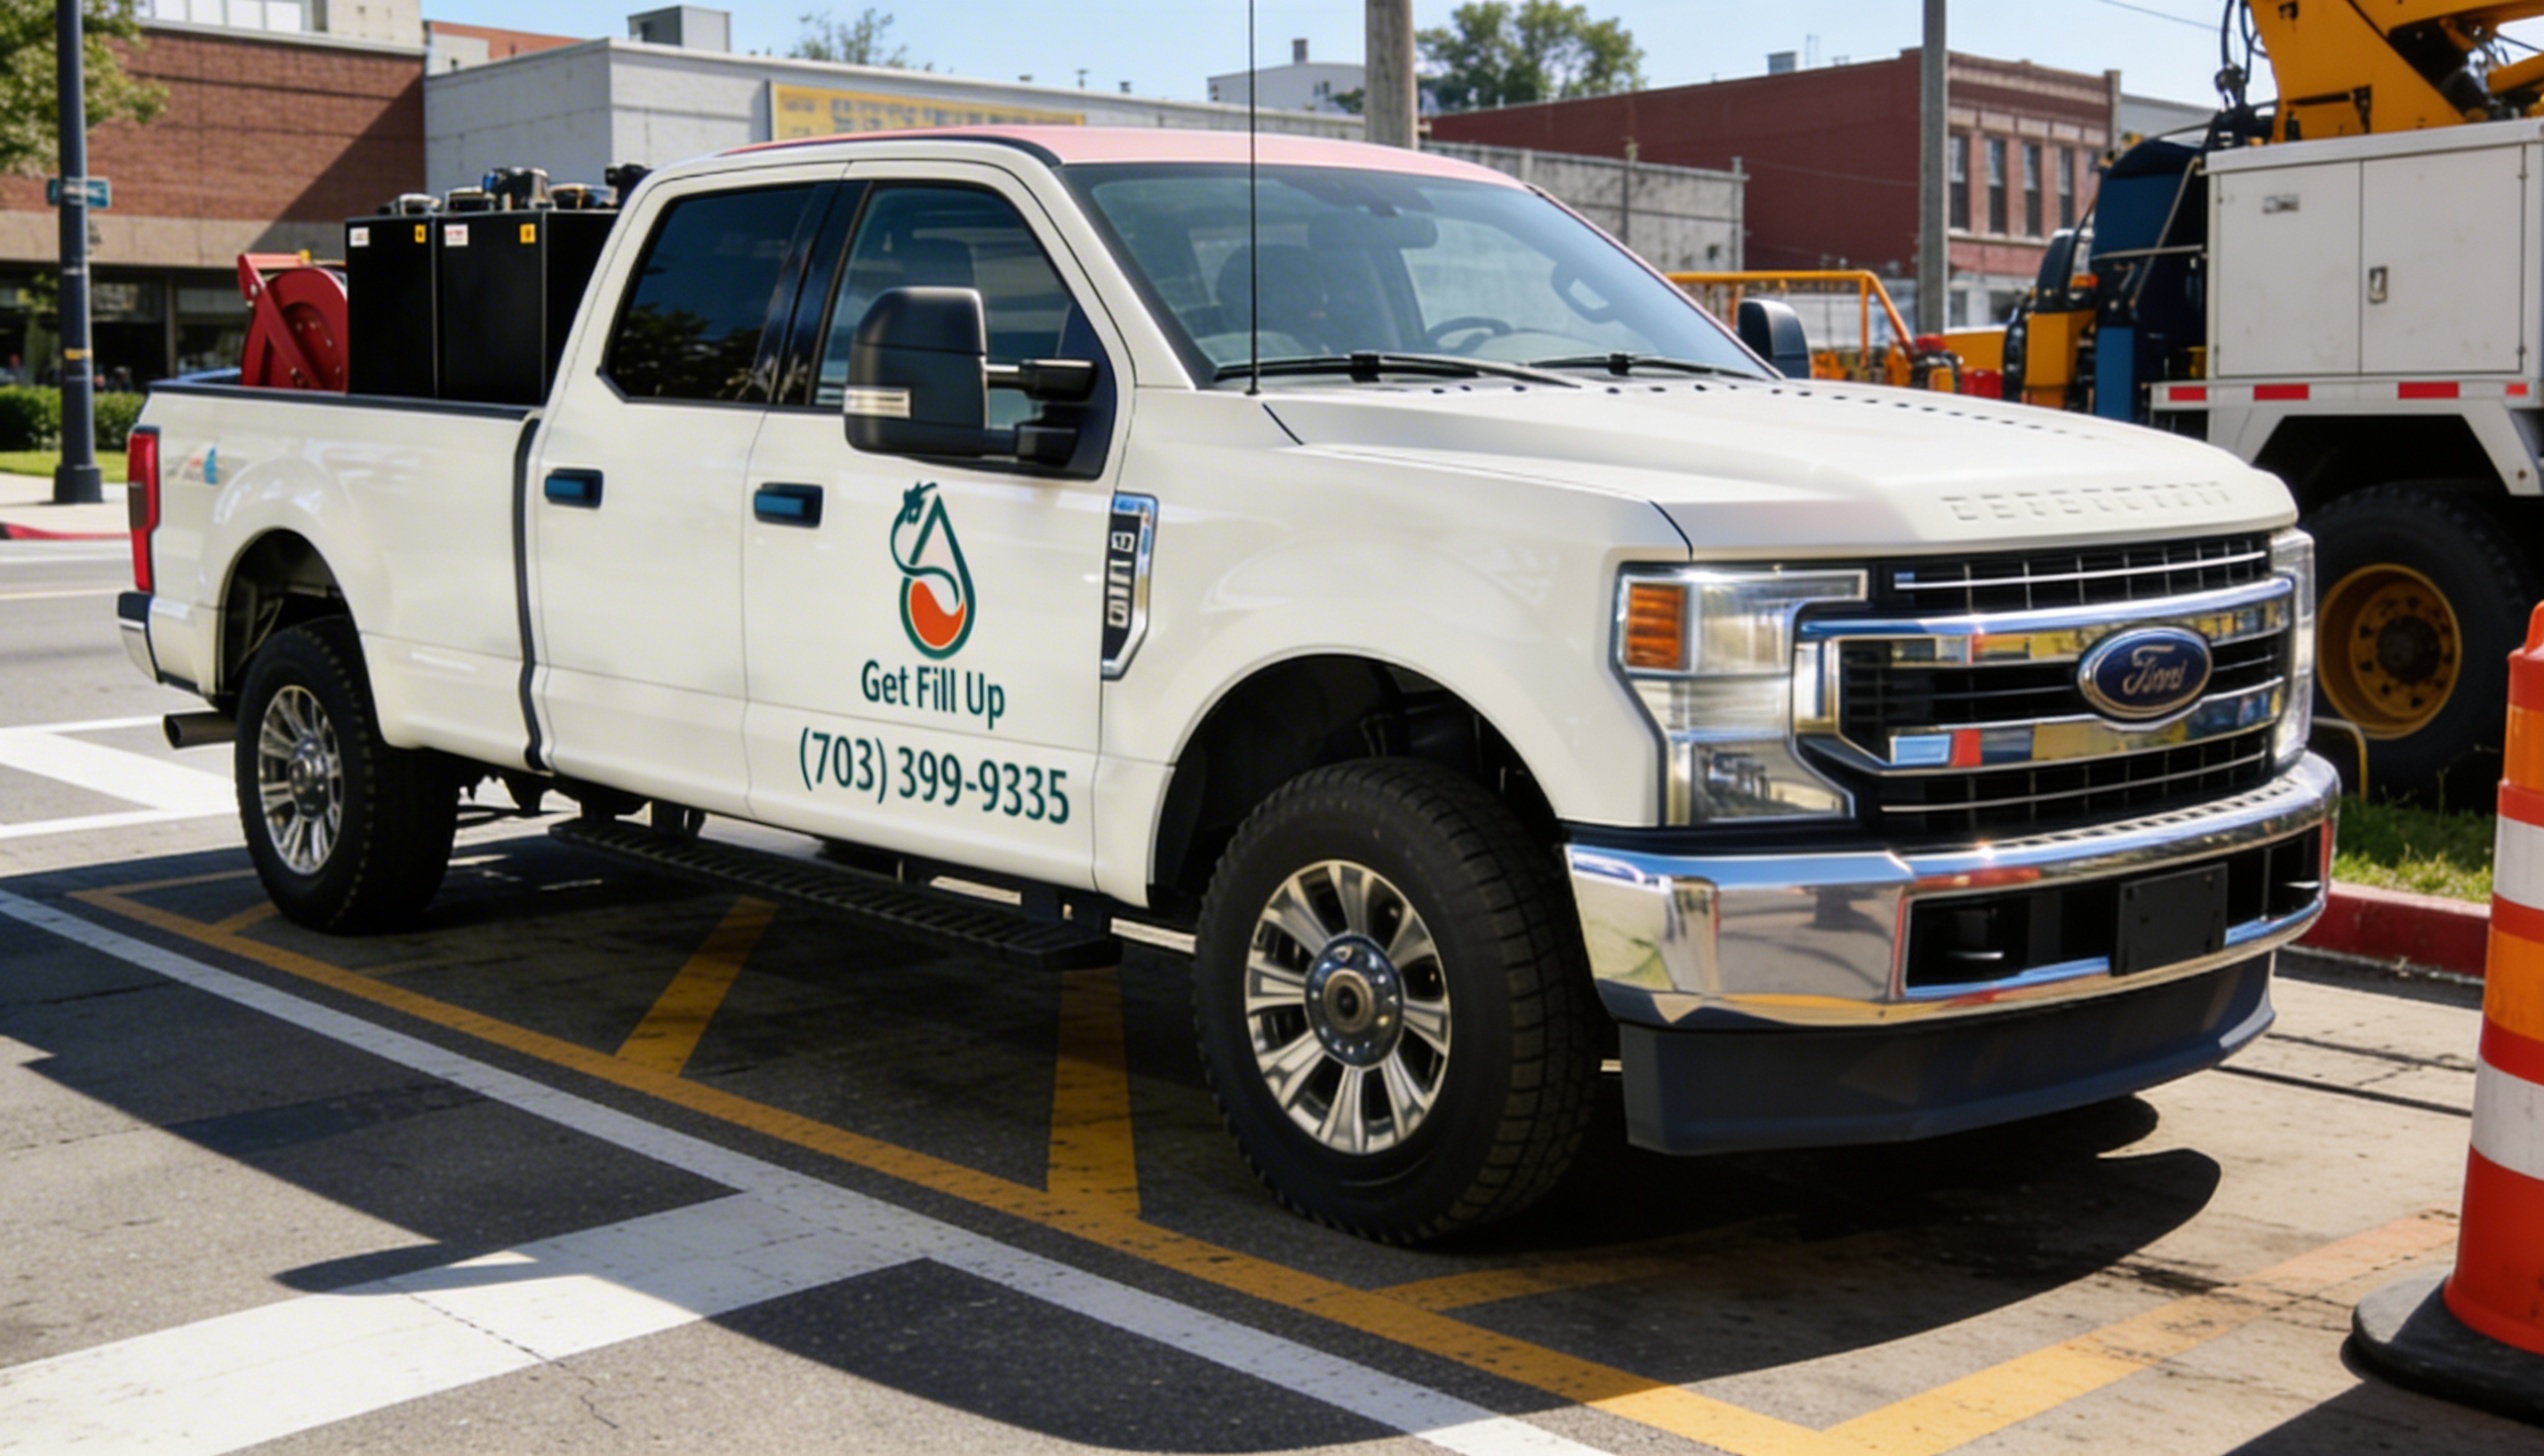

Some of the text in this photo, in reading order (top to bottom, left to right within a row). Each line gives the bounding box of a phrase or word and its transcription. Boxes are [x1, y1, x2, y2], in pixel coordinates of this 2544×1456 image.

[861, 659, 1006, 730] Get Fill Up
[2122, 643, 2187, 695] Ford
[799, 727, 1071, 825] (703) 399-9335
